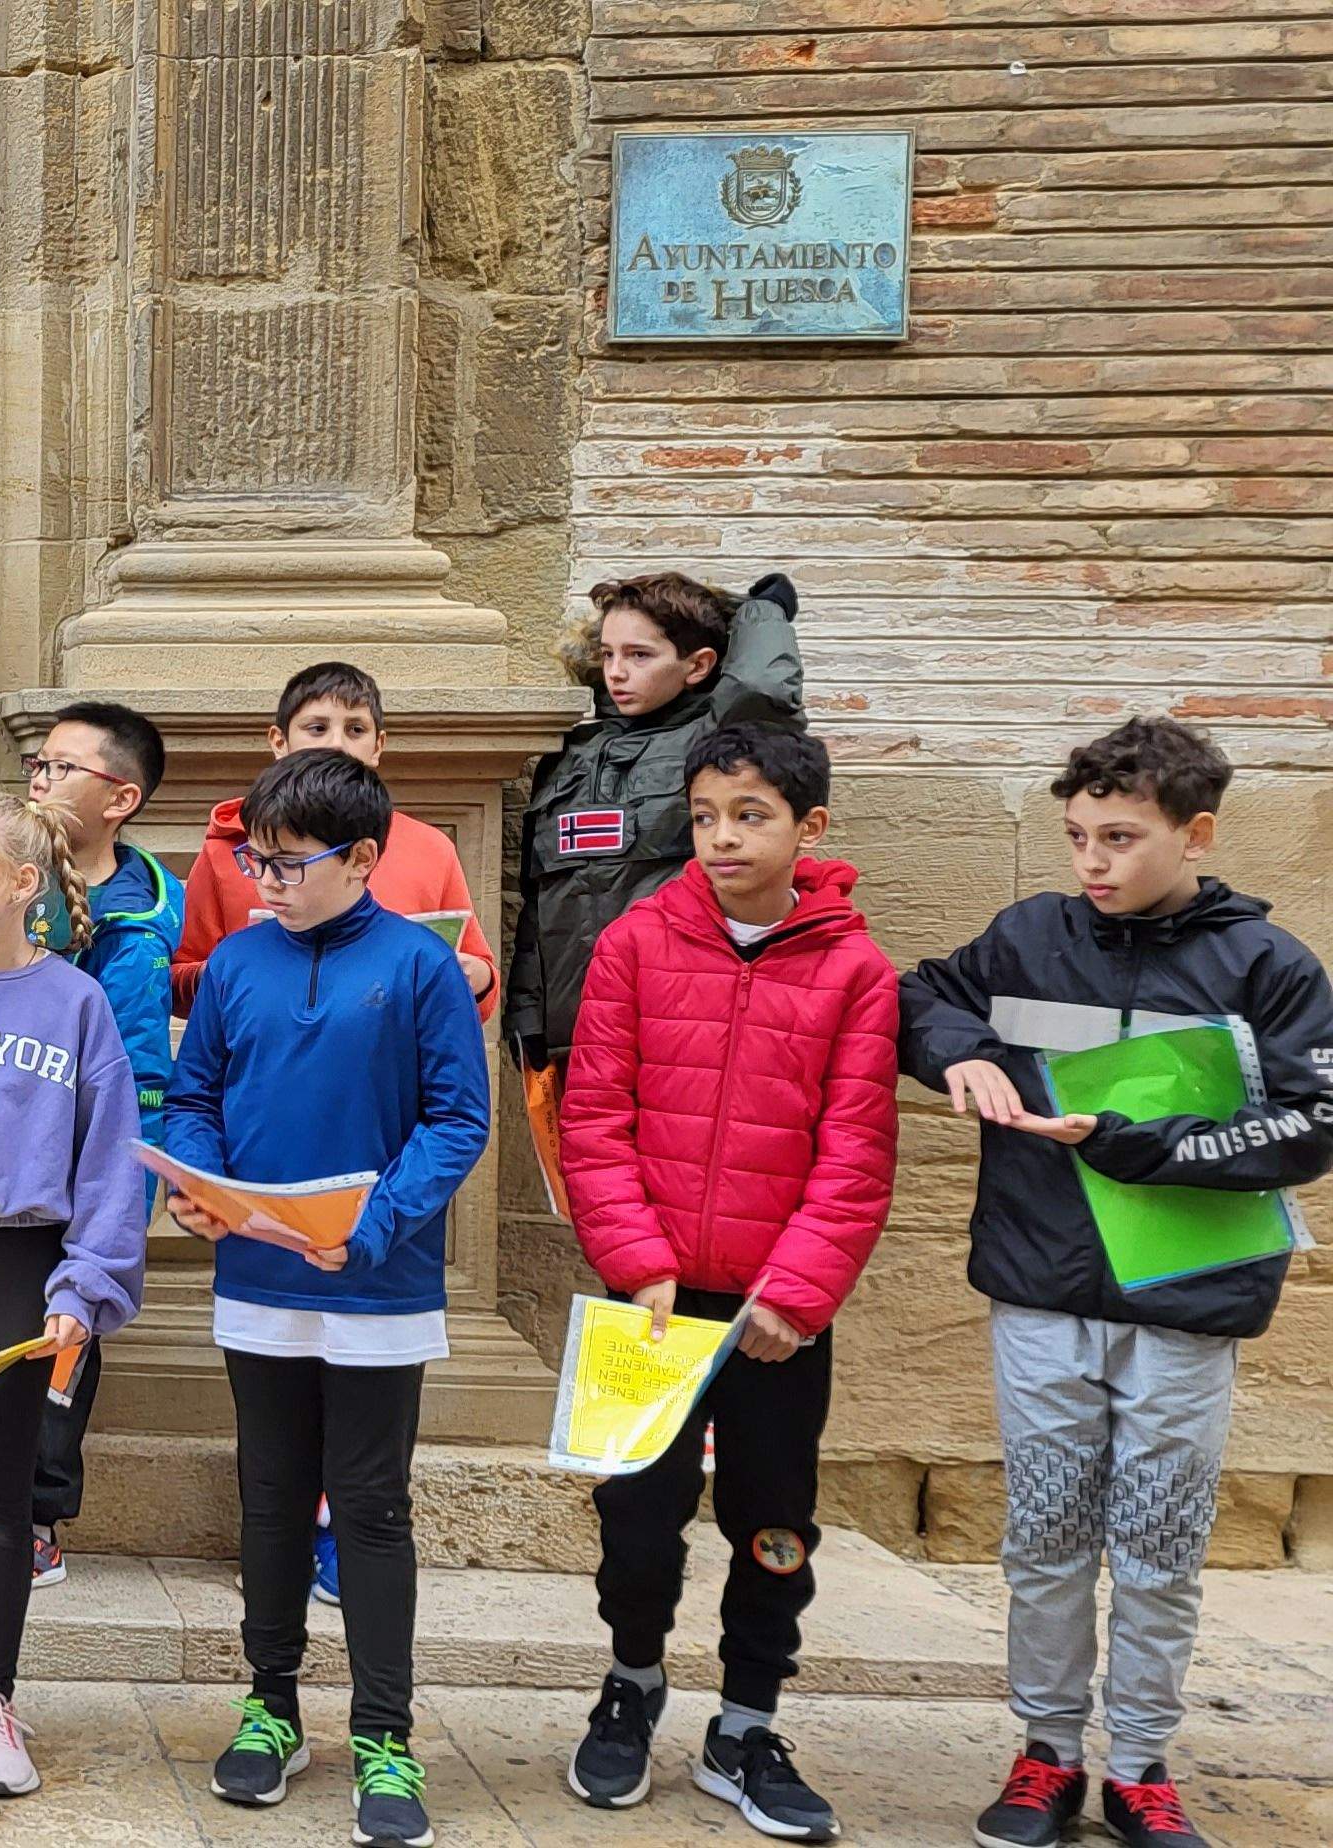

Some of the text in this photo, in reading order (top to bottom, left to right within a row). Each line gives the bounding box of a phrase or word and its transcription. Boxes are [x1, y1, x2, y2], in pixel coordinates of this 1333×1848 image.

[627, 232, 898, 272] AYUNTAMIENTO
[661, 277, 858, 321] DE HUESCA
[1176, 1109, 1313, 1162] MISSION
[599, 1368, 632, 1383] BIEN
